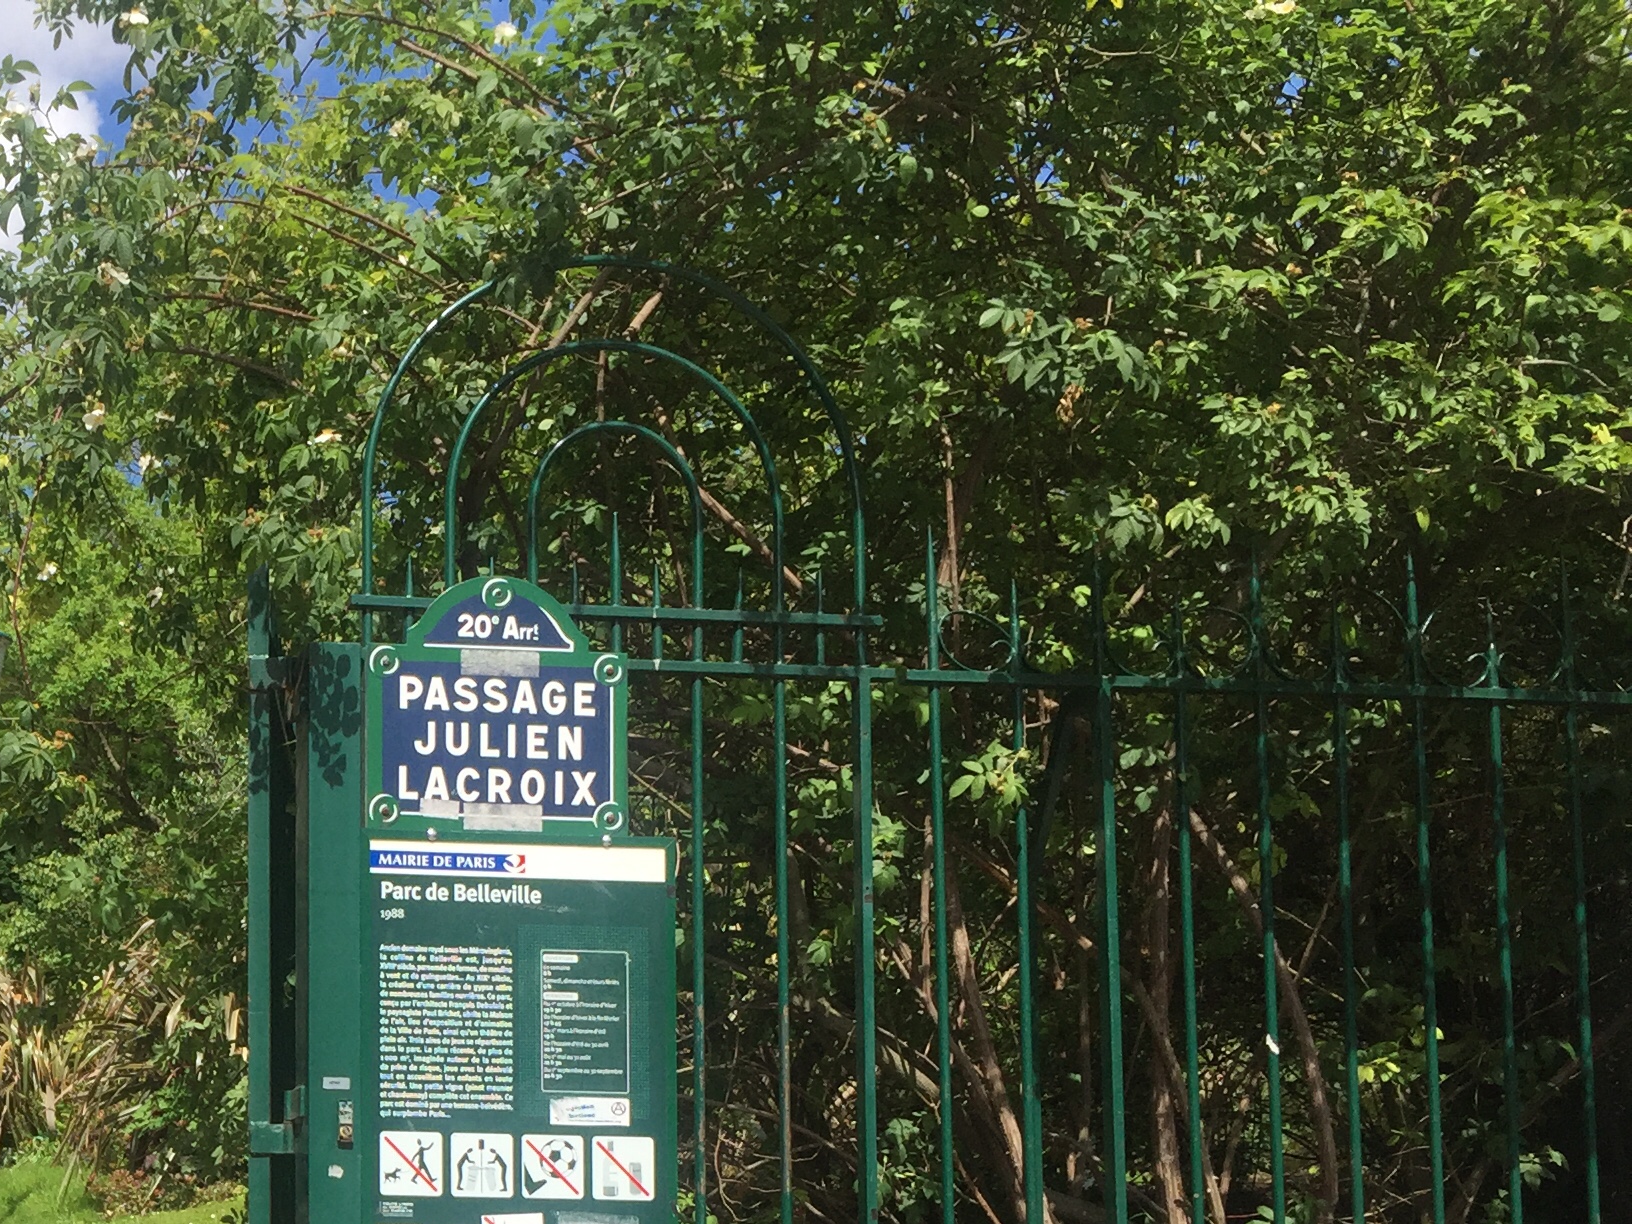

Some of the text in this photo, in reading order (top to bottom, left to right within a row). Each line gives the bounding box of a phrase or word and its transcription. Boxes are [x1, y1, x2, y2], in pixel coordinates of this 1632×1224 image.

[399, 675, 596, 717] PASSAGE
[414, 722, 583, 761] JULIEN
[398, 765, 597, 806] LACROIX
[378, 853, 496, 869] MAIRIE DE PARIS
[380, 882, 542, 904] Parc de Belleville
[380, 909, 404, 920] 1988
